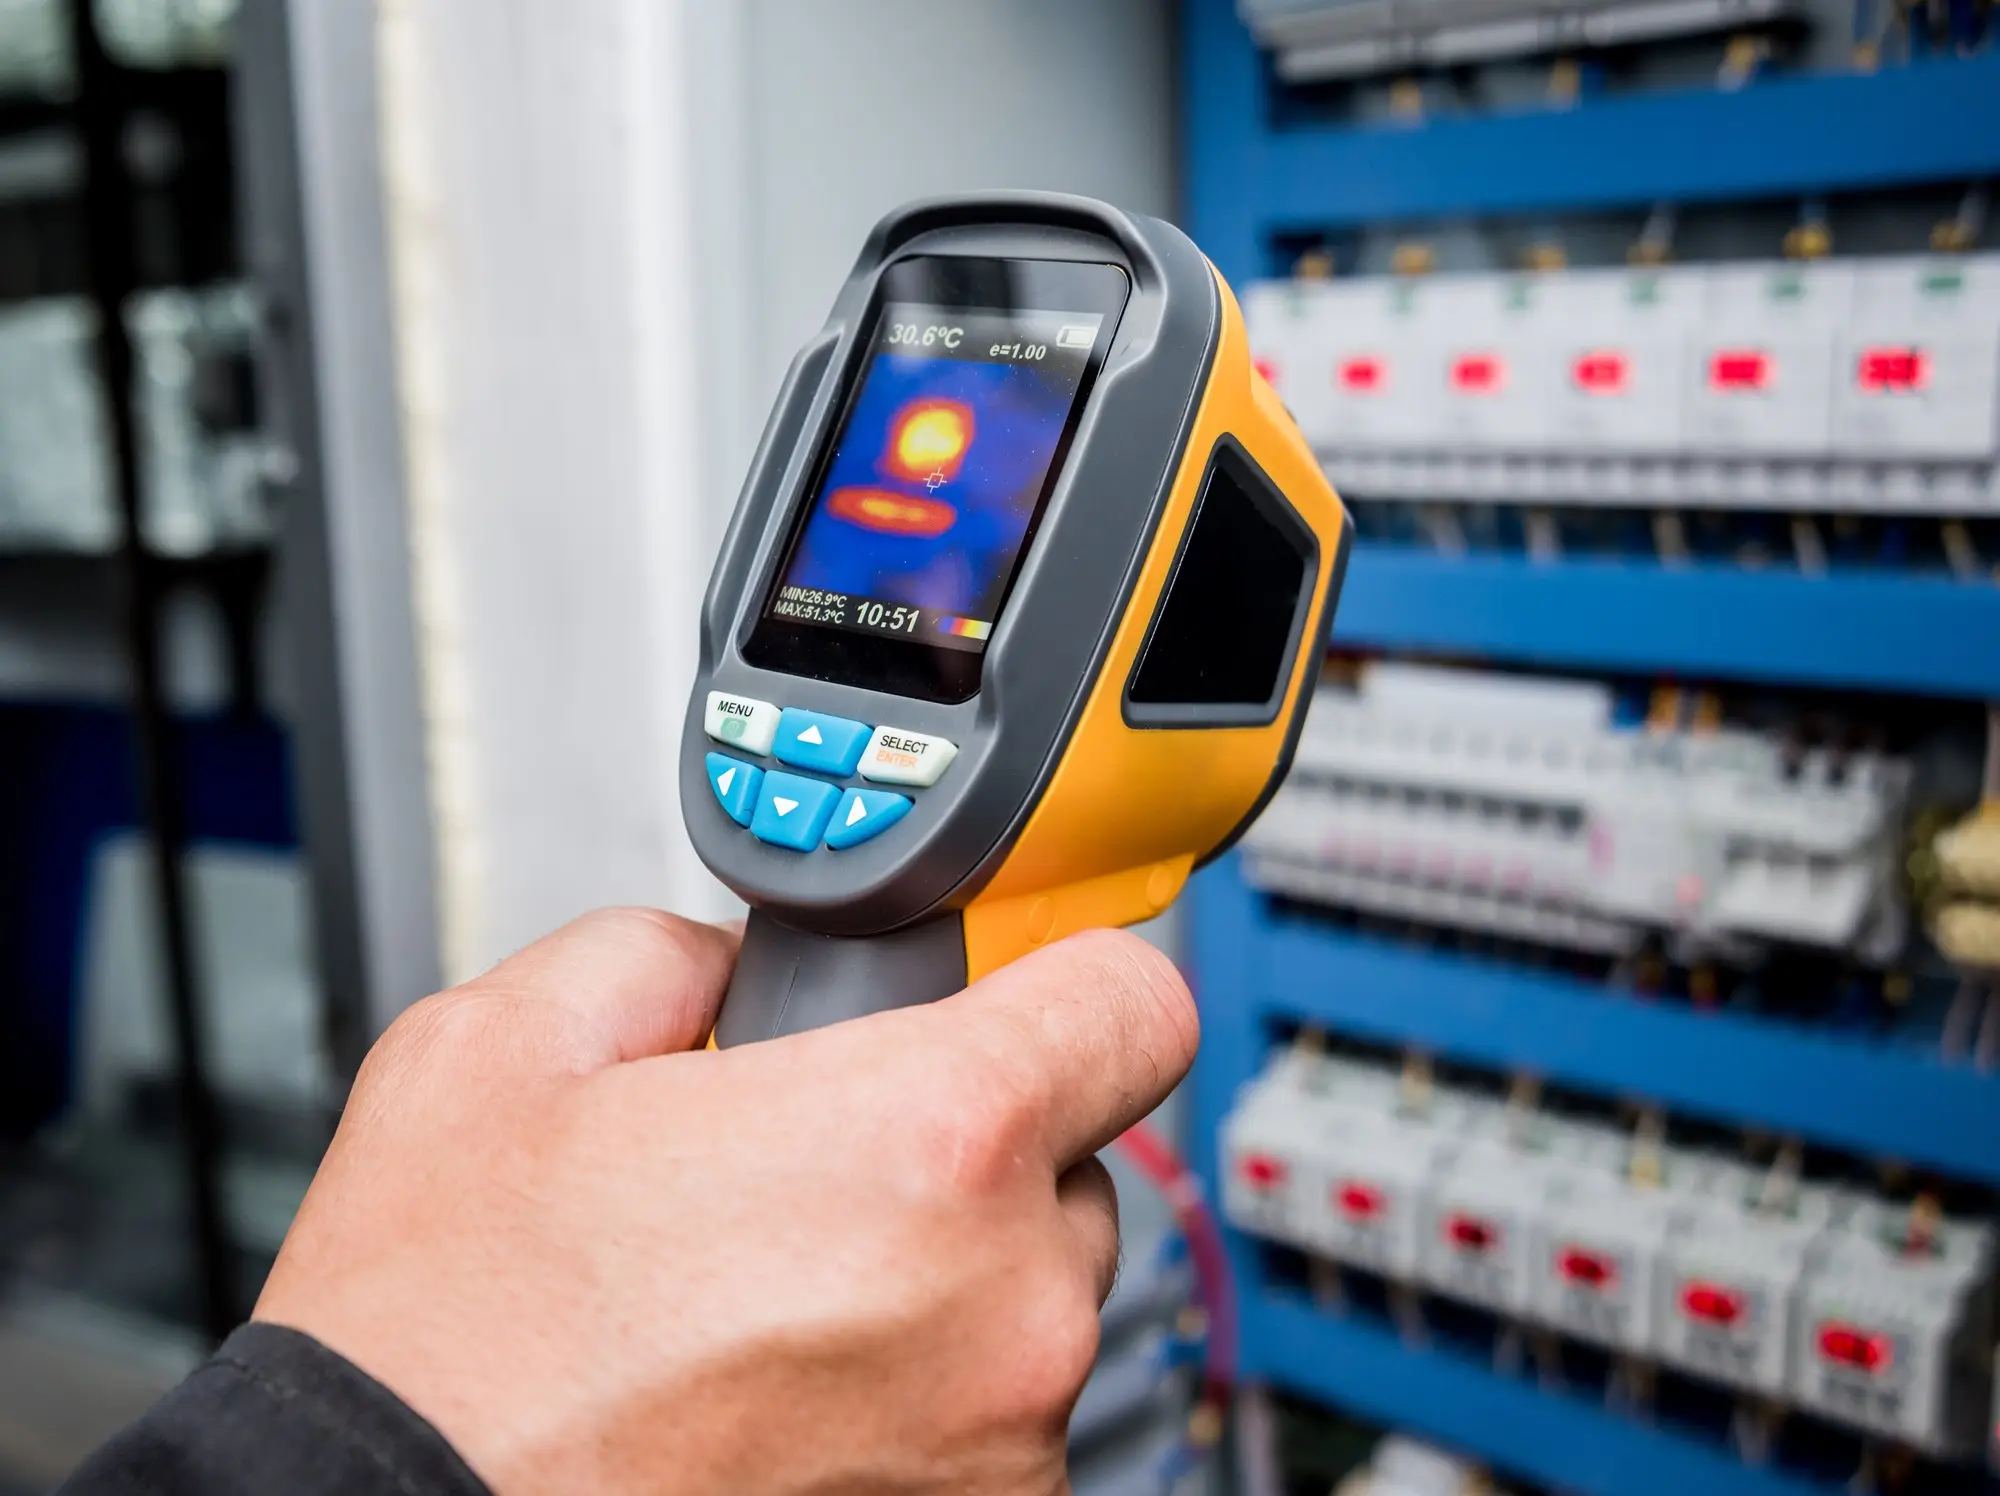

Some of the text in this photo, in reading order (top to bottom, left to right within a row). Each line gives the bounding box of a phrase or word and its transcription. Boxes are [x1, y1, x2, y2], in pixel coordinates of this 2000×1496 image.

[989, 342, 1047, 360] e=1.00
[856, 601, 920, 633] 10:51
[716, 700, 754, 717] MENU
[879, 735, 929, 755] SELECT
[875, 751, 919, 769] ENTER
